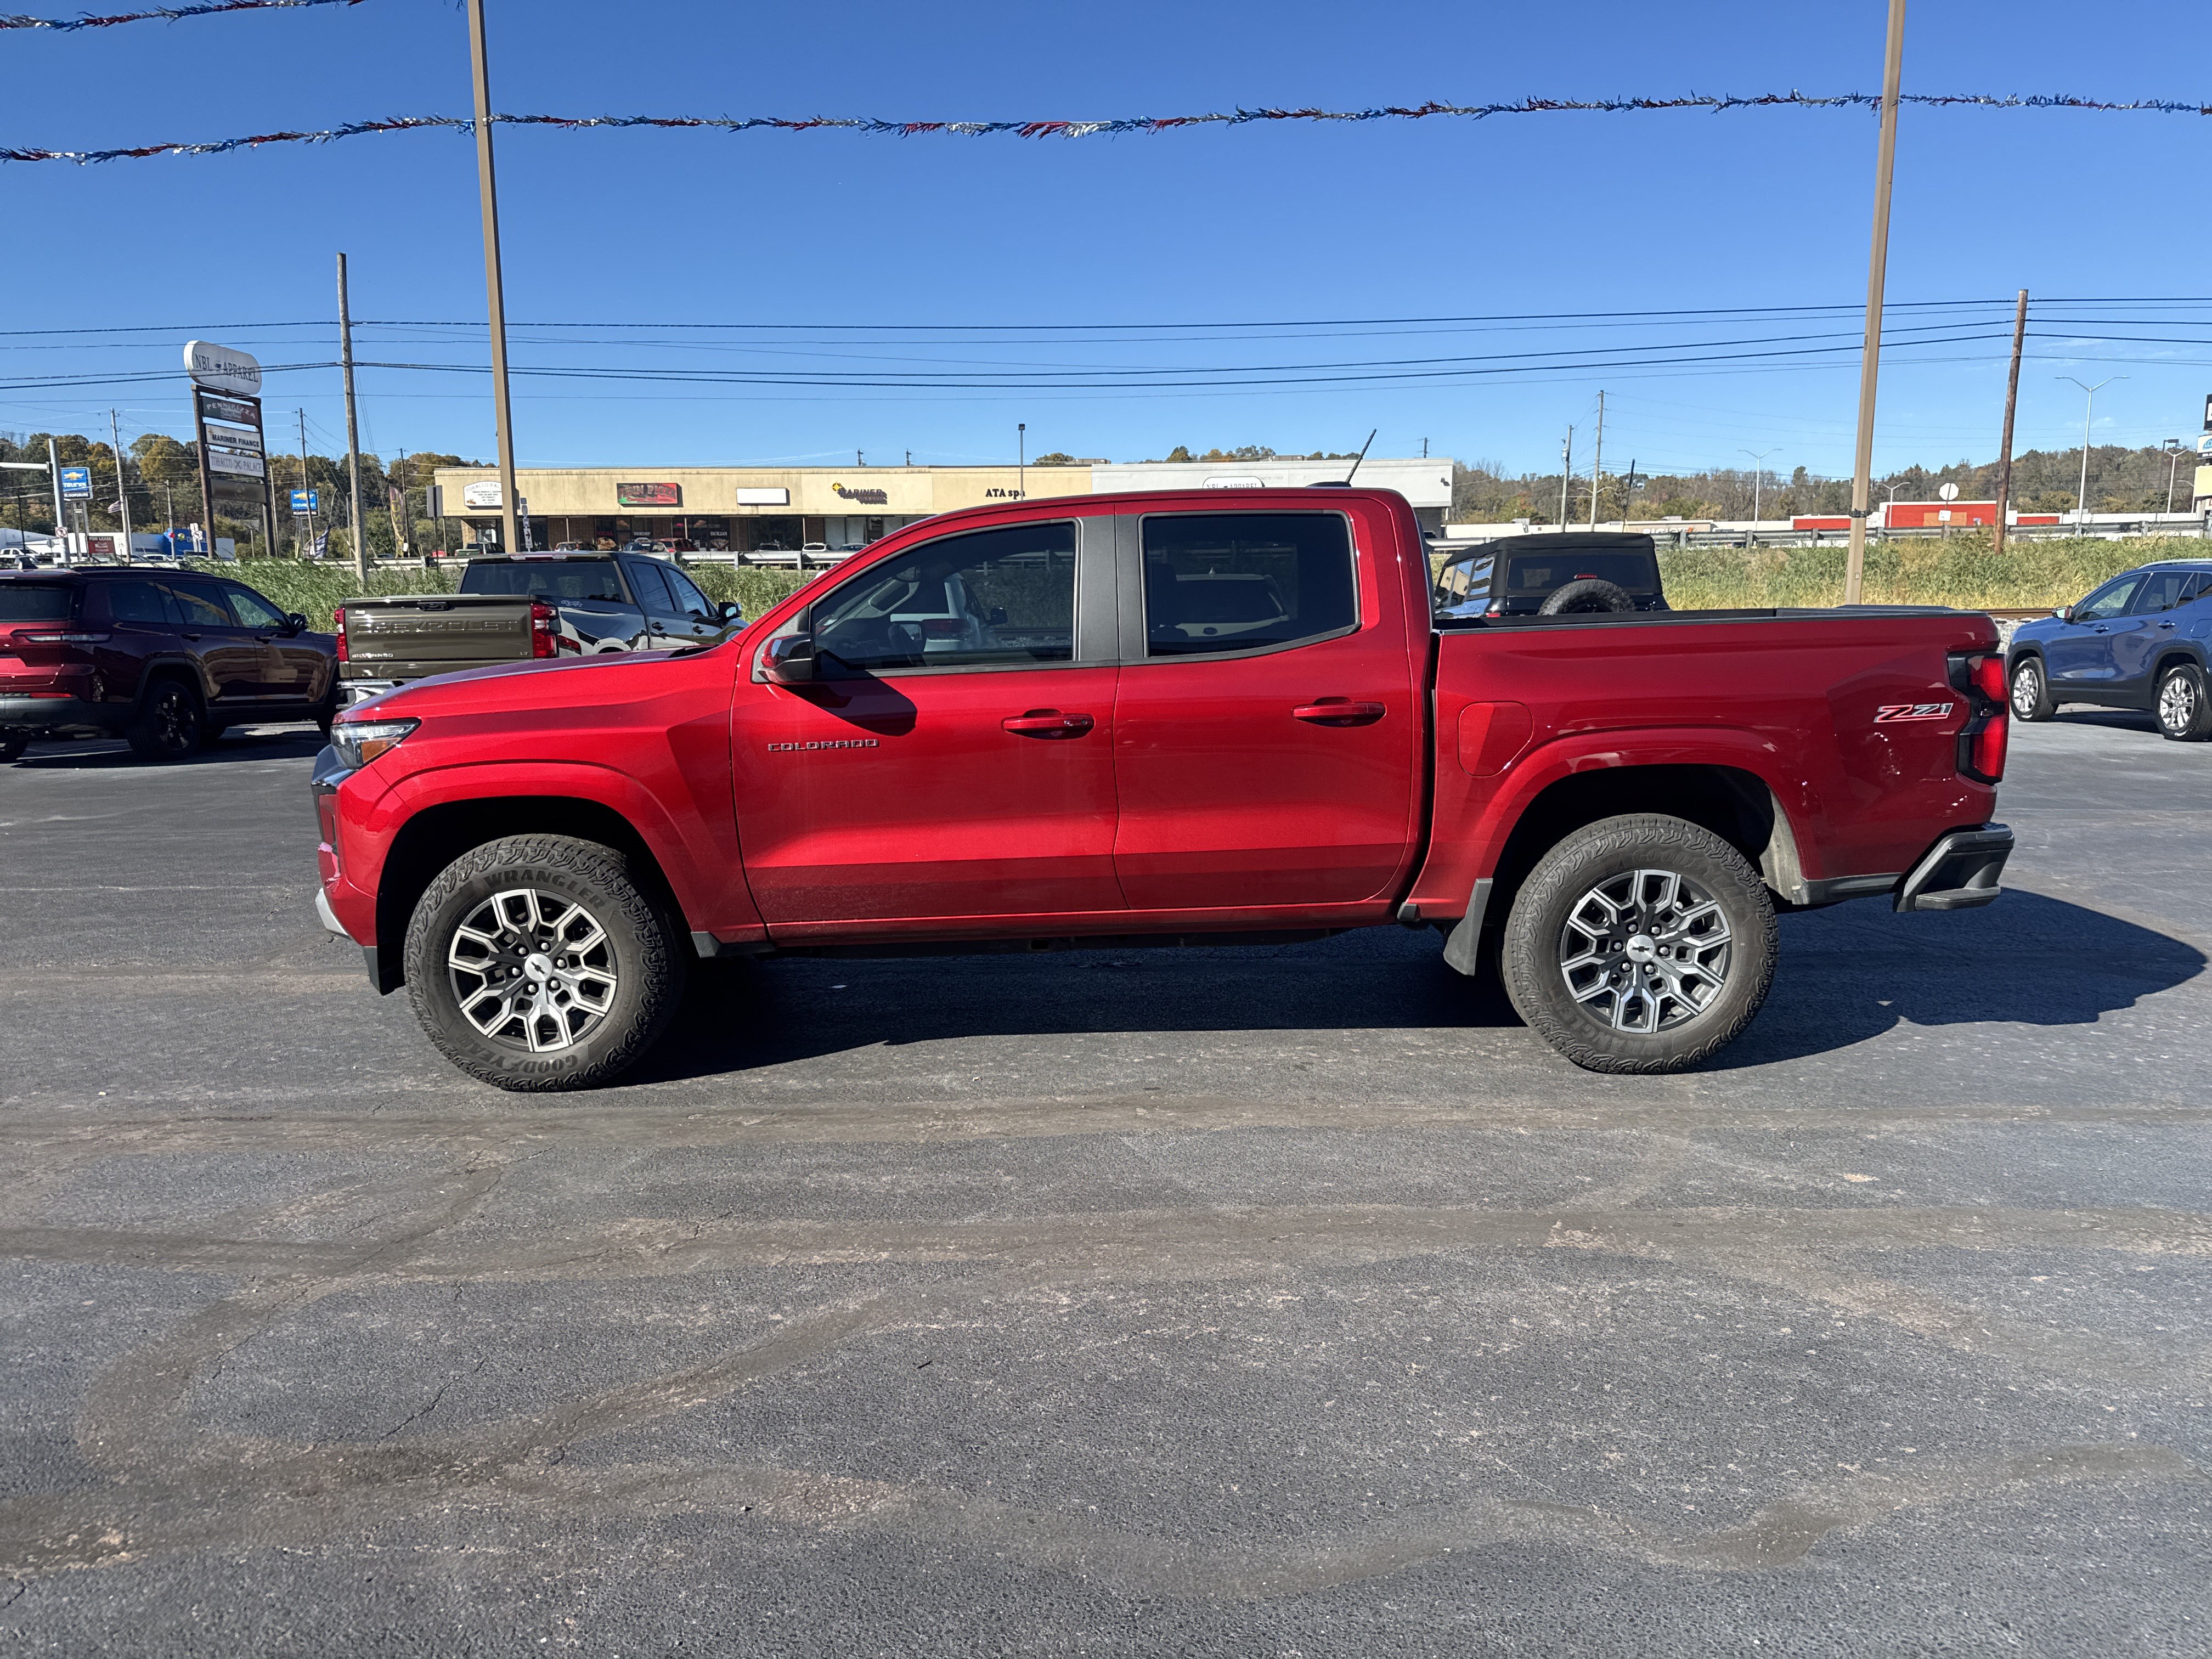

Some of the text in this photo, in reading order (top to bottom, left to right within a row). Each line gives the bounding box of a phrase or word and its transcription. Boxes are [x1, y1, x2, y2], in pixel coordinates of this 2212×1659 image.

[195, 354, 258, 383] NBL APPAREL
[206, 402, 228, 411] PENN
[231, 403, 256, 420] PIZZA
[212, 433, 259, 448] MARINER FINANCE
[211, 456, 262, 472] TOBACCO PALACE
[465, 483, 489, 493] TOBACCO
[985, 488, 1007, 498] ATA
[357, 620, 518, 634] CHEVROLET
[1874, 703, 1954, 723] Z71
[768, 739, 878, 752] COLORADO
[483, 869, 605, 910] WRANGLER
